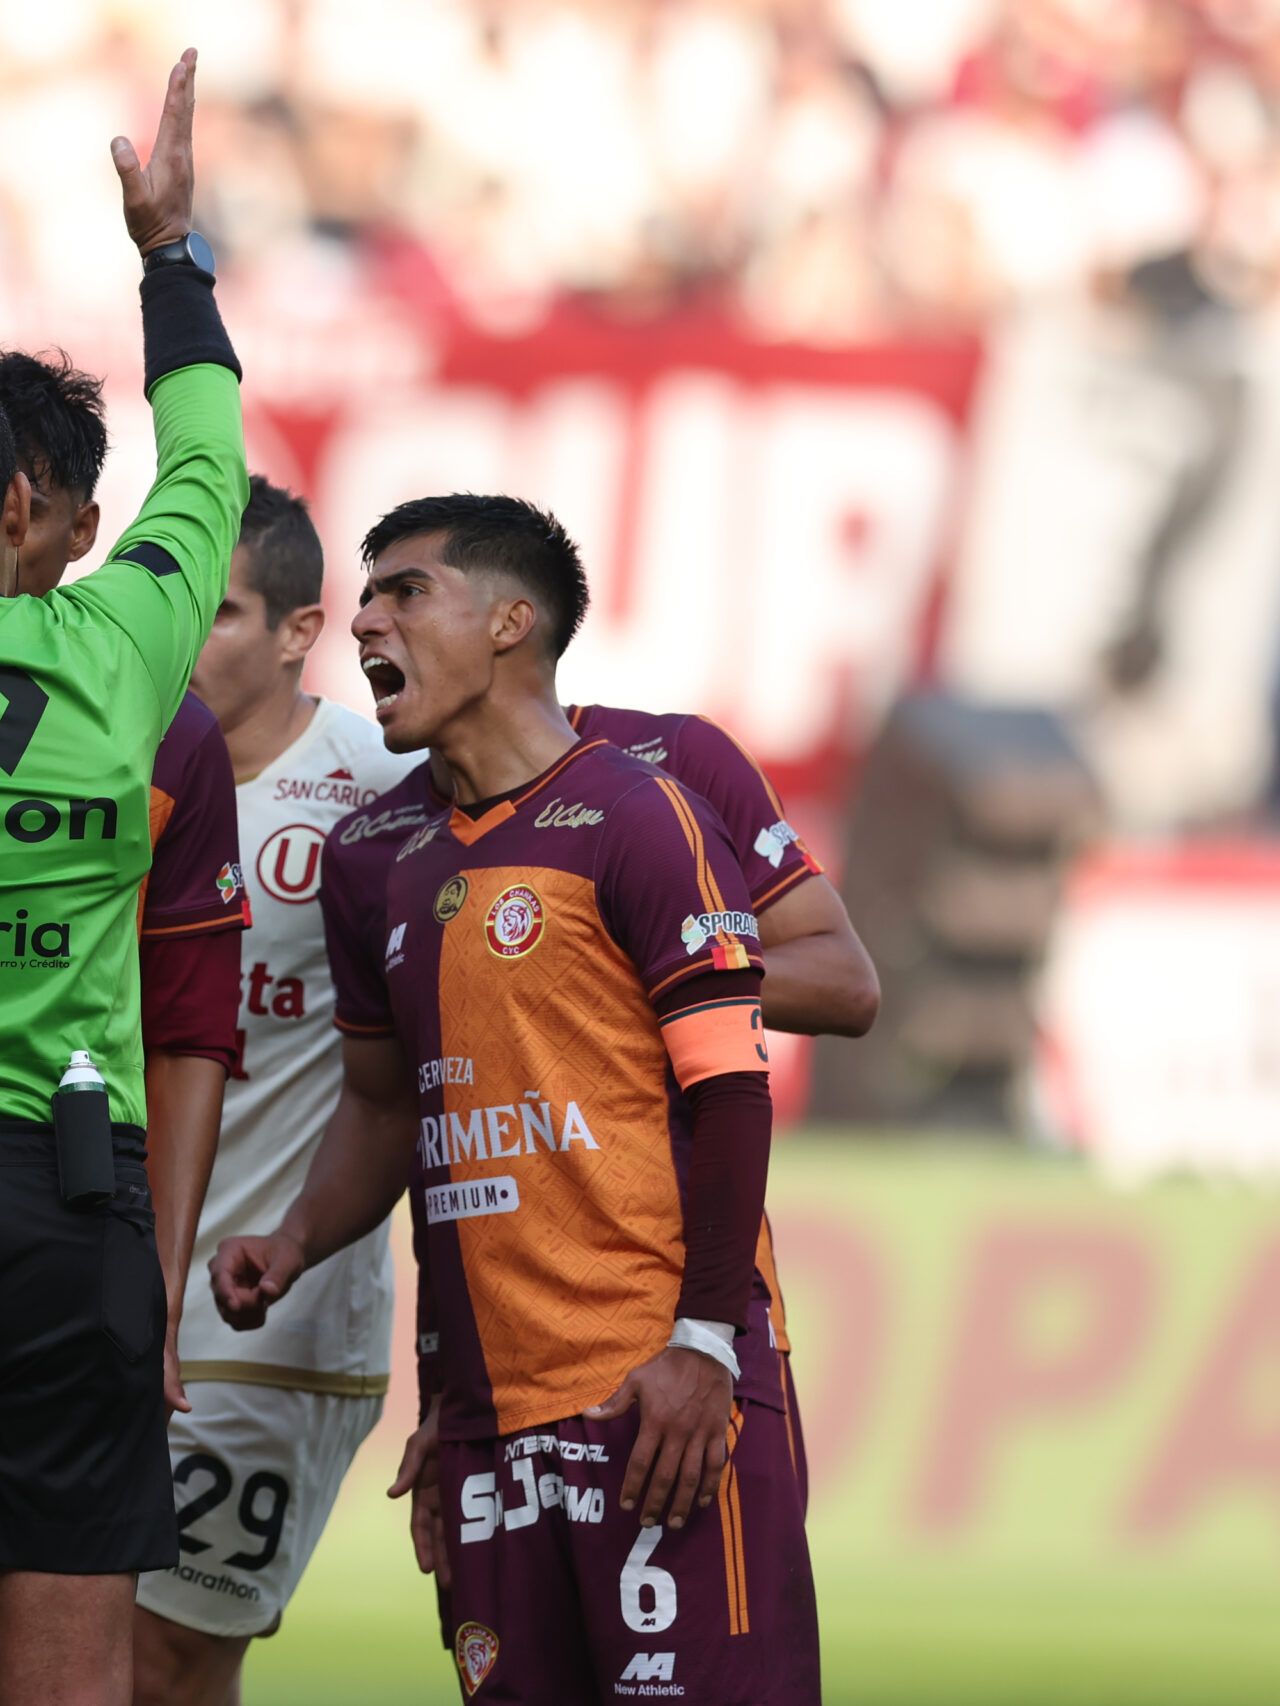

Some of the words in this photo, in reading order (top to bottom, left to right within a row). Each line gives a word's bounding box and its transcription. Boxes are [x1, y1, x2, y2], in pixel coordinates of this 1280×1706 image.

[274, 778, 313, 800] SAN
[315, 782, 380, 807] CARLO
[274, 838, 320, 893] U
[20, 961, 26, 970] y
[29, 959, 70, 969] Crédito
[418, 1056, 474, 1094] CERVEZA
[417, 1090, 601, 1170] RIMEÑA
[427, 1184, 498, 1217] PREMIUM
[173, 1452, 290, 1572] 29
[620, 1524, 677, 1633] 6
[614, 1683, 636, 1695] New
[638, 1683, 685, 1696] Athletic
